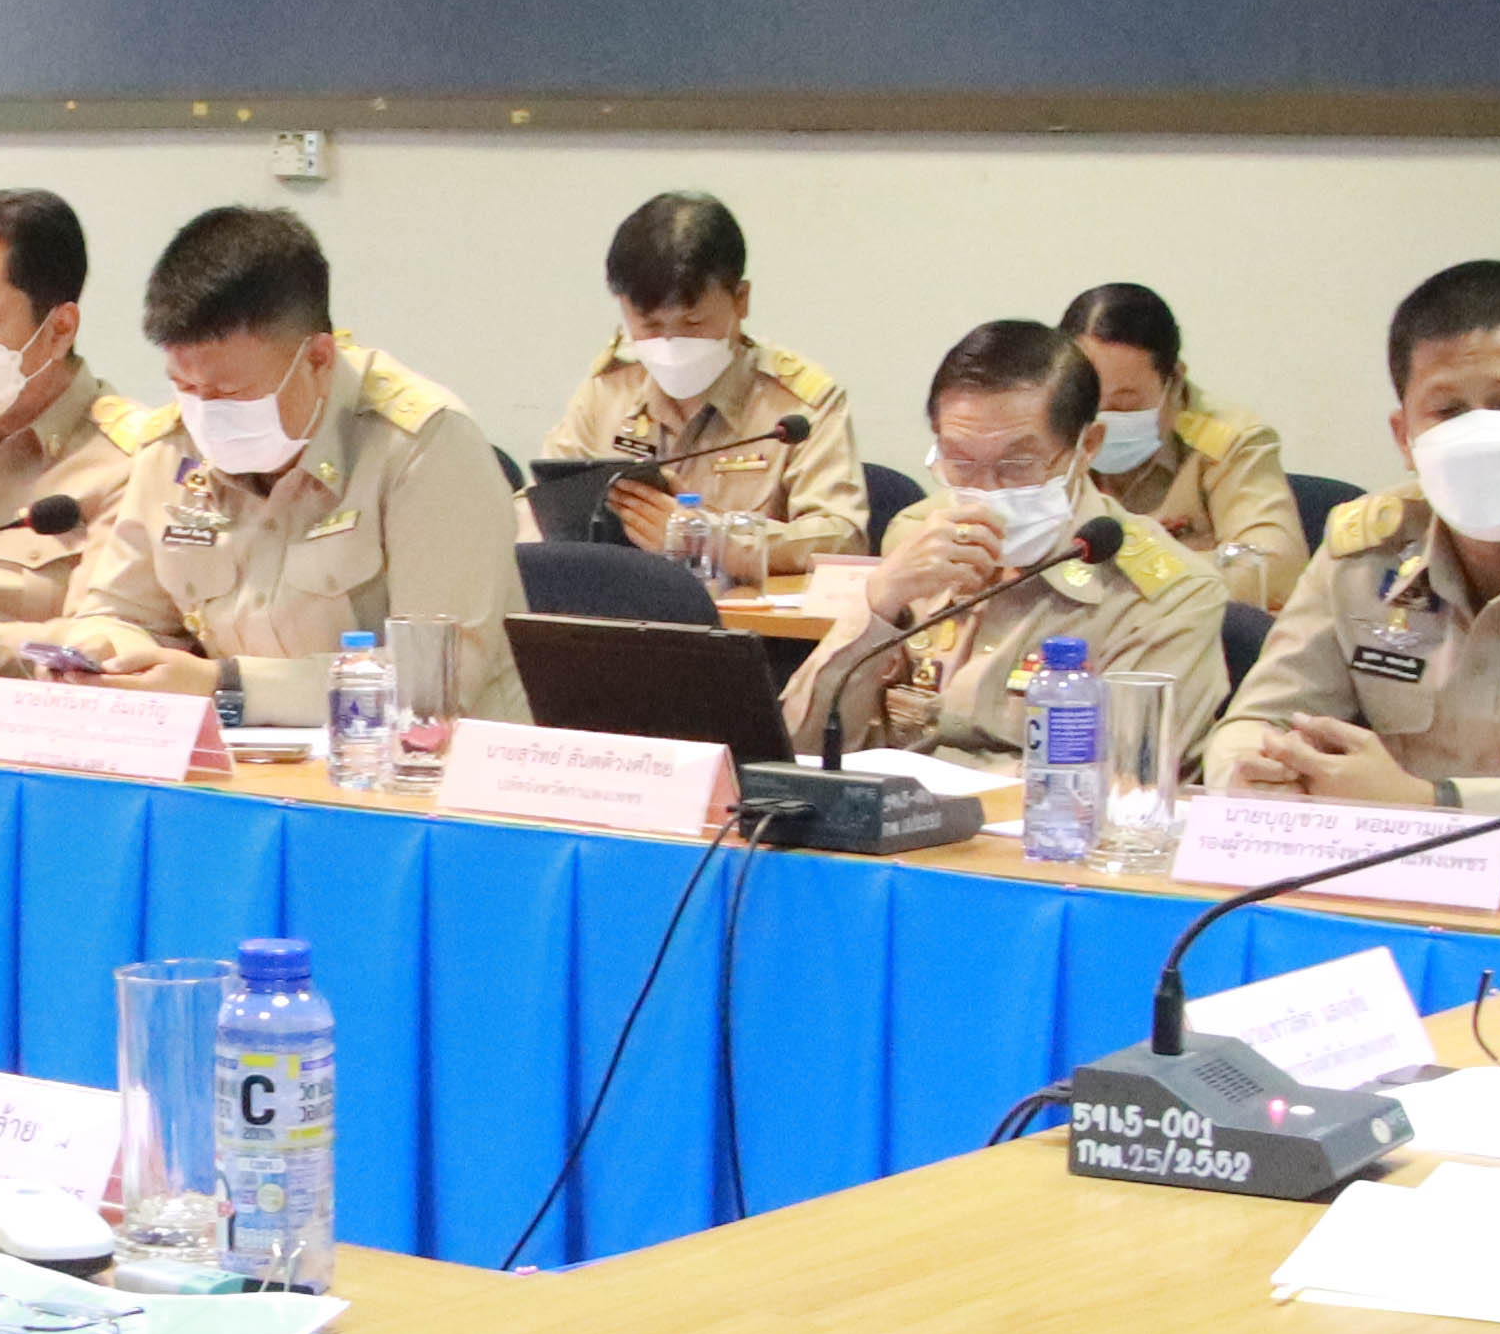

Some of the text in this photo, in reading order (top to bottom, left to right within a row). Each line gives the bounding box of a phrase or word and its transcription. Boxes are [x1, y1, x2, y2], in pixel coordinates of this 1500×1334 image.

[1028, 719, 1041, 750] C
[1354, 815, 1470, 838] หอมยามเย็
[241, 1074, 276, 1126] C
